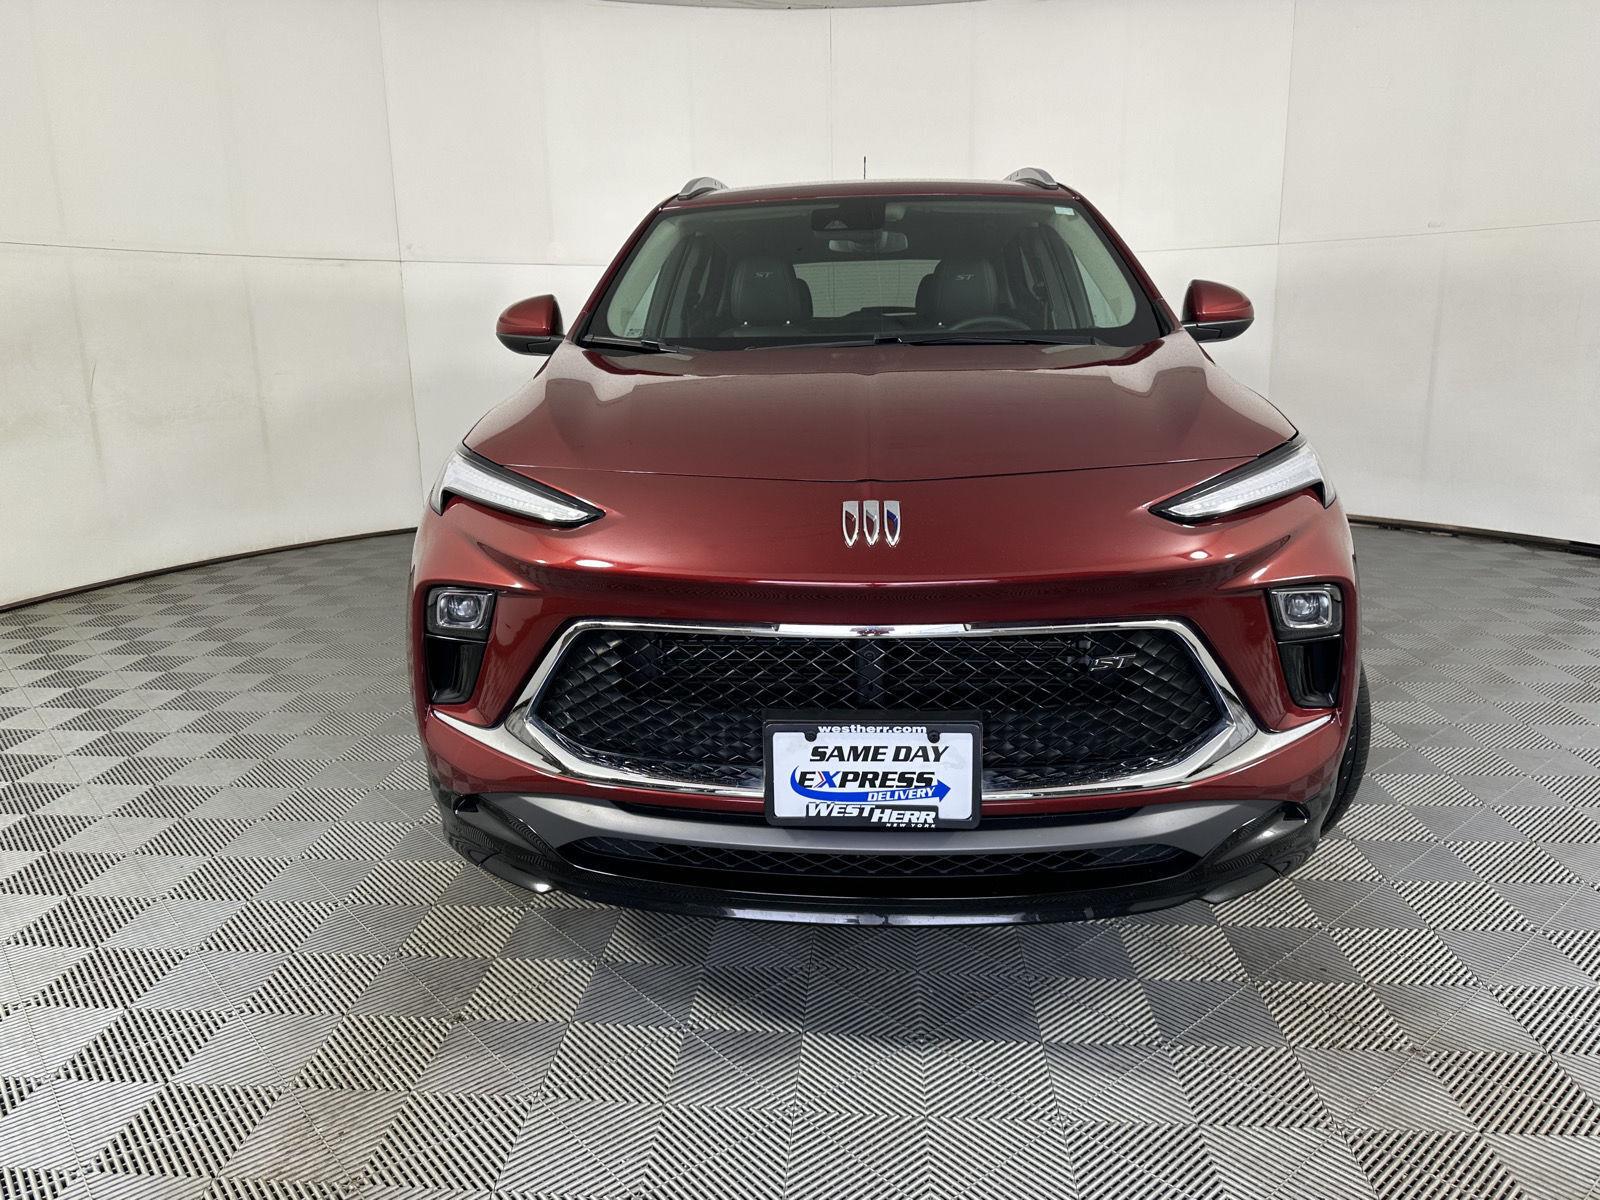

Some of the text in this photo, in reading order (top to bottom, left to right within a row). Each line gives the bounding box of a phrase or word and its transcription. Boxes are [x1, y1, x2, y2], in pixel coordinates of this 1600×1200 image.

[955, 273, 976, 281] ST
[817, 725, 928, 734] westherr.com
[809, 746, 950, 763] SAME DAY
[798, 771, 936, 789] EXPRESS
[867, 786, 936, 802] DELIVERY
